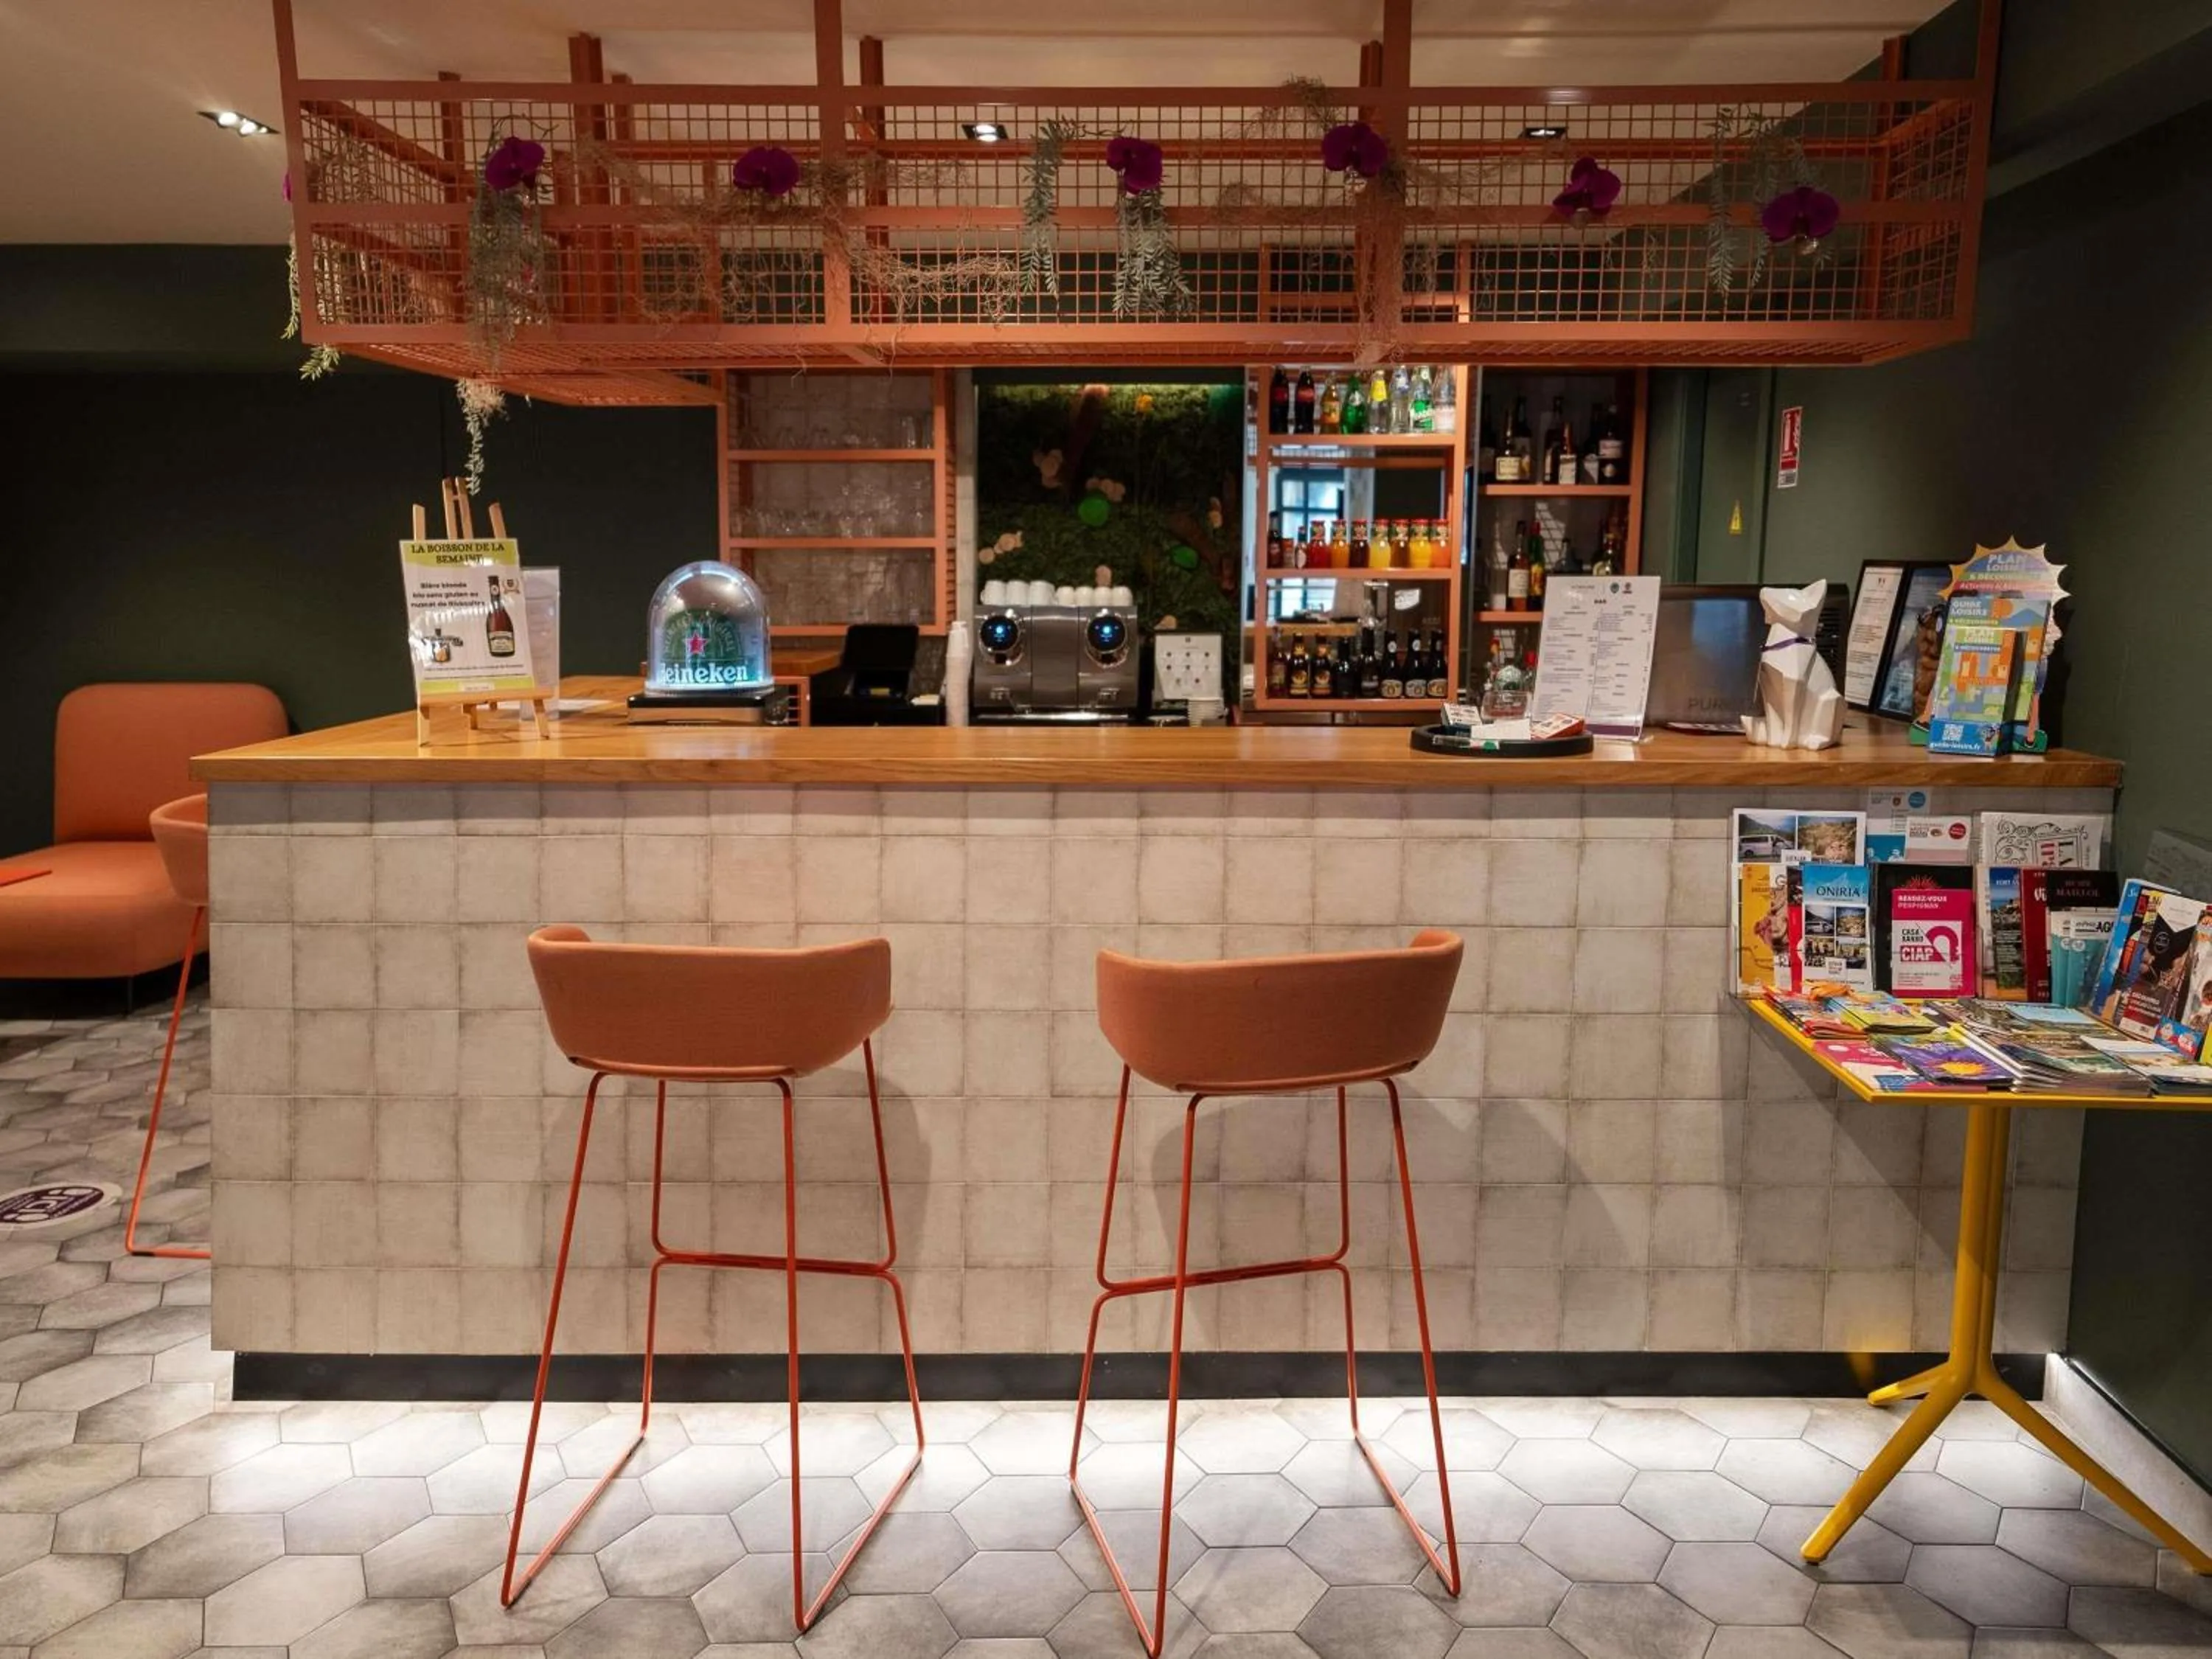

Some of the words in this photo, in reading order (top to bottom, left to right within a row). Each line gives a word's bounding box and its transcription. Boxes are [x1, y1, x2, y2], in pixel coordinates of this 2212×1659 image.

[411, 544, 425, 553] LA
[427, 543, 473, 553] BOISSON
[476, 543, 490, 552] DE
[490, 542, 505, 552] LA
[1816, 885, 1860, 897] ONIRIA
[1902, 947, 1934, 961] CIAP
